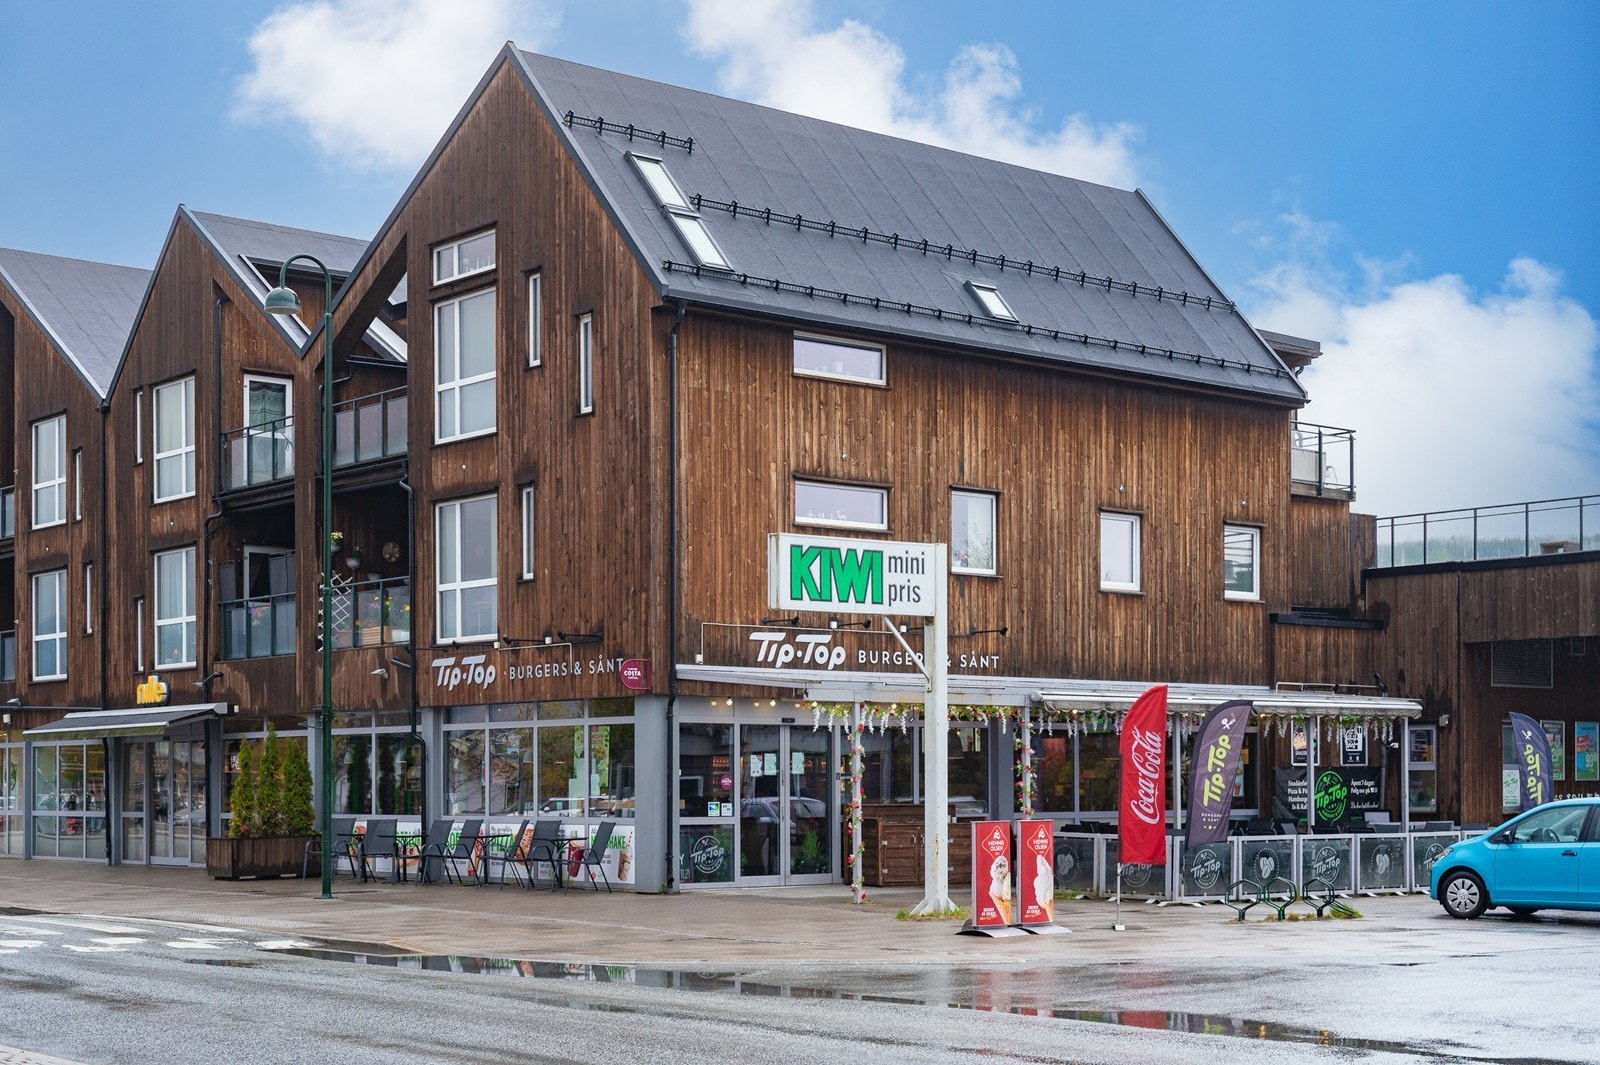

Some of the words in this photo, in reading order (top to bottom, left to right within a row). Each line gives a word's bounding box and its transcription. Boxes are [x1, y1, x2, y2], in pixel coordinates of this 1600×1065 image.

[790, 544, 884, 605] KIWI
[888, 550, 925, 575] mini
[888, 579, 921, 607] pris
[509, 662, 567, 680] BURGERS
[574, 661, 582, 675] &
[589, 654, 624, 674] SÅNT
[960, 650, 999, 669] SÅNT
[136, 675, 166, 705] nille
